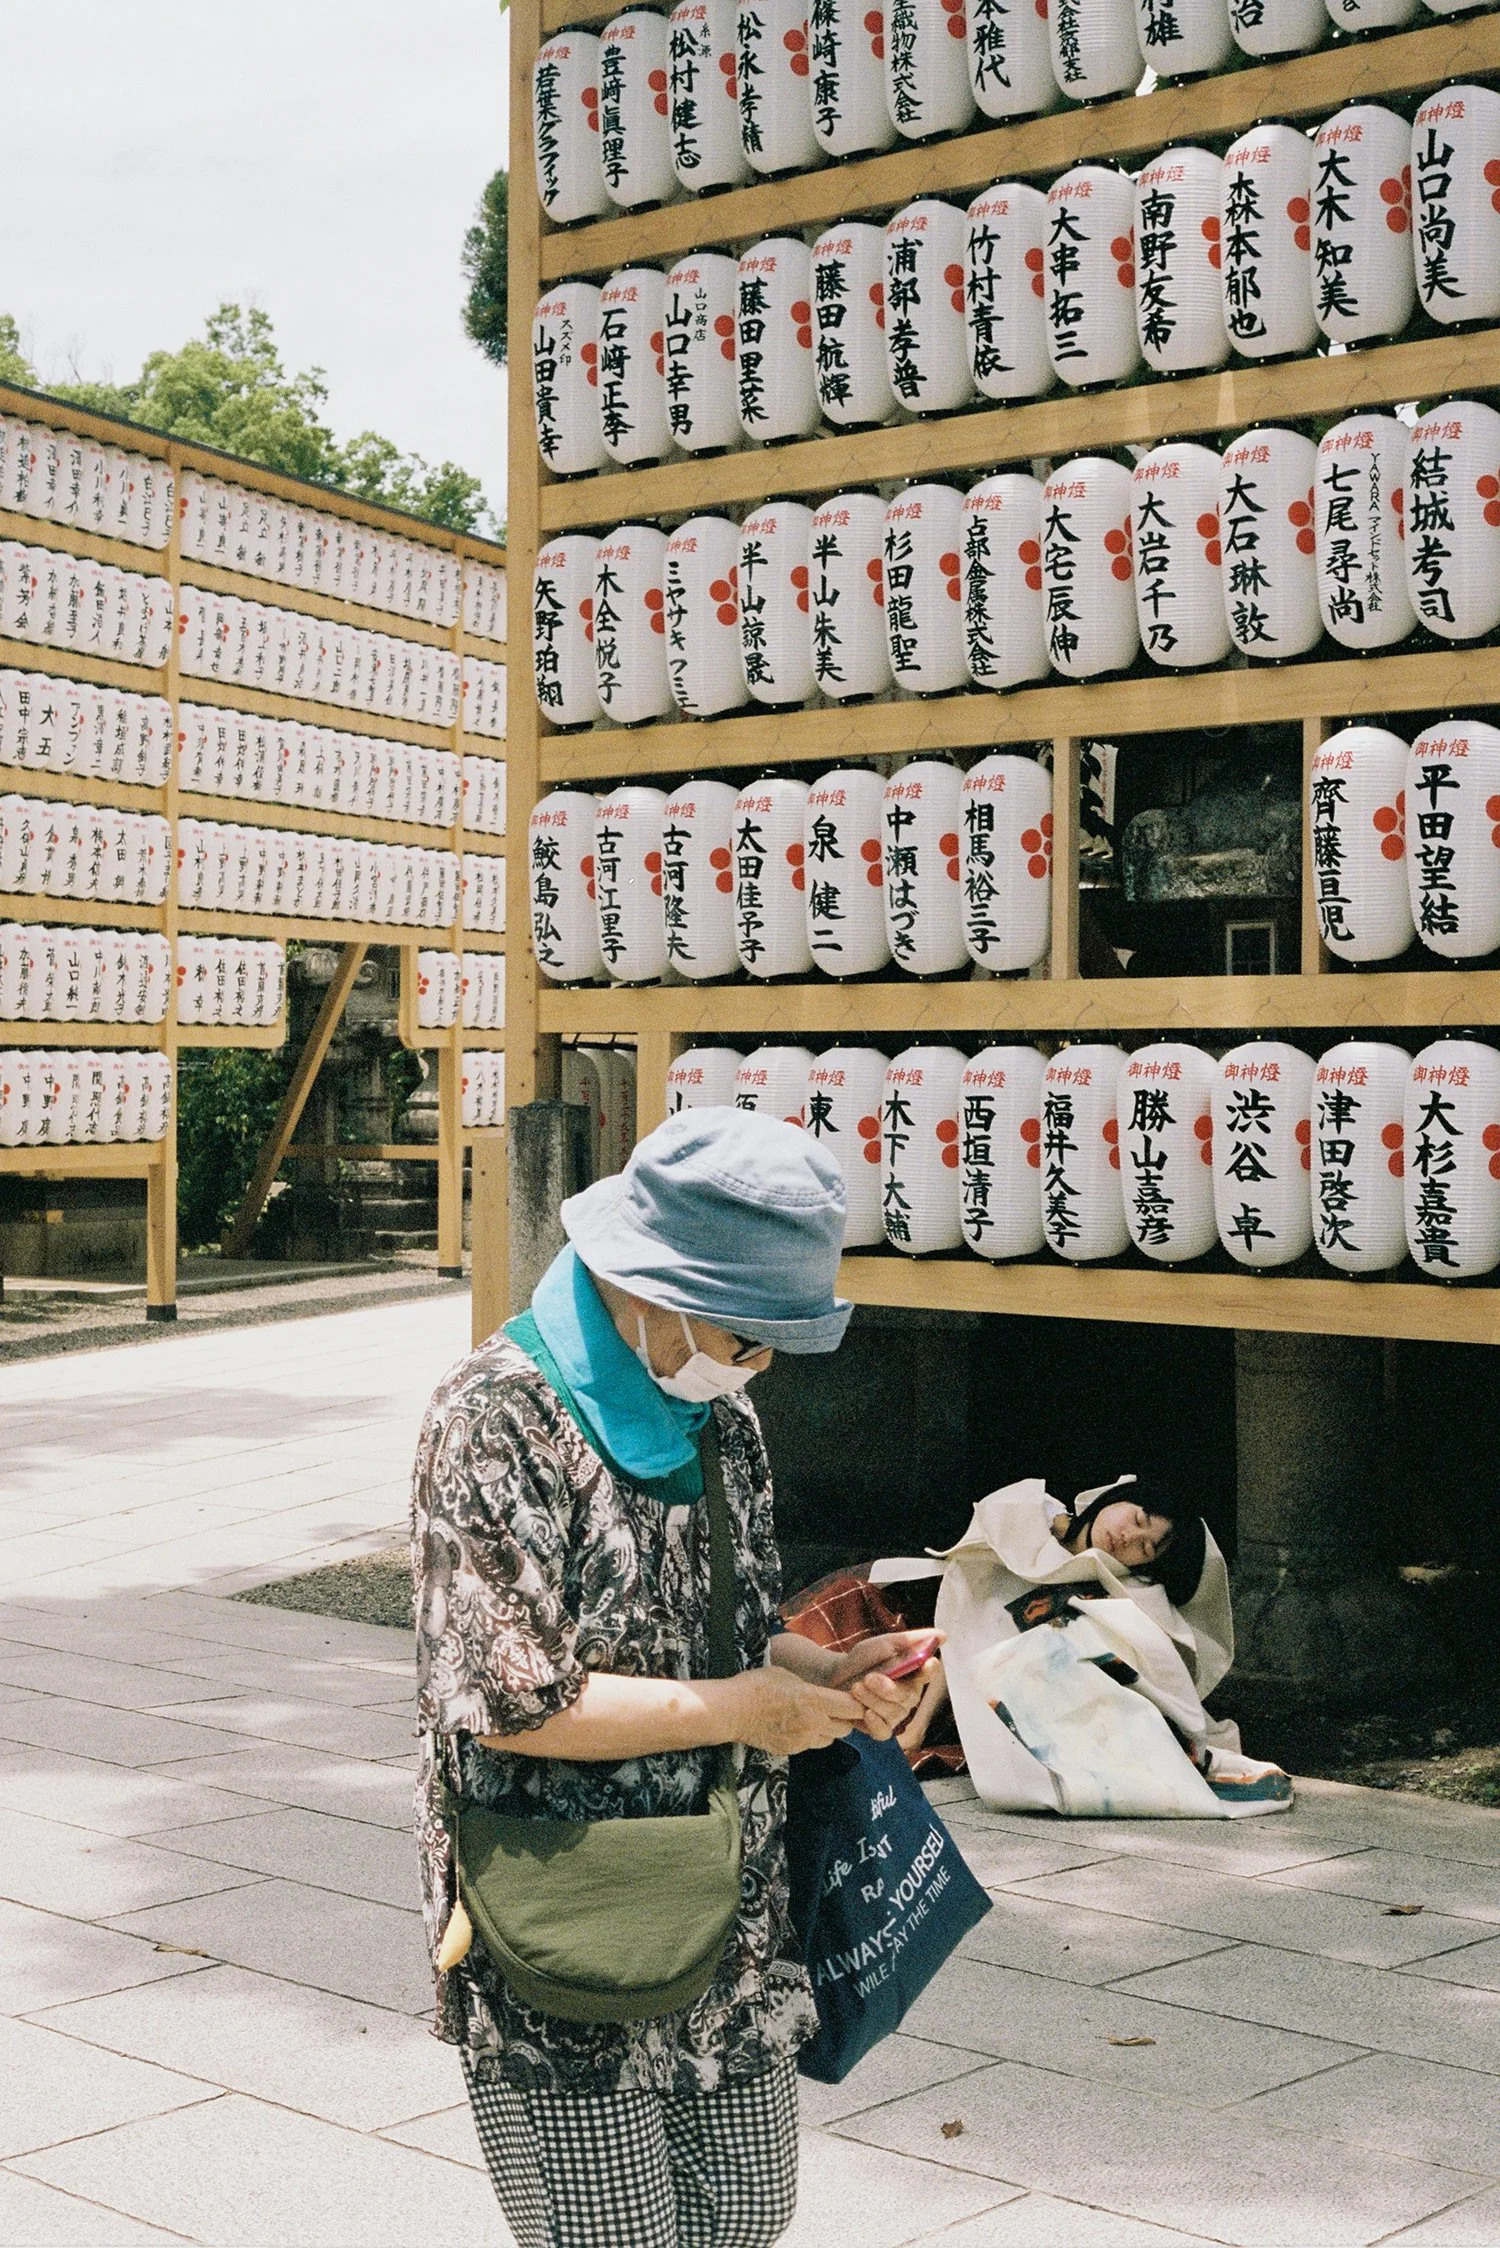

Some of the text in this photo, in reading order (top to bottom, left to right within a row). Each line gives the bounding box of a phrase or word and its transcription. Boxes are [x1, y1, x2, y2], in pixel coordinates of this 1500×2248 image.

[669, 27, 702, 171] 松村健志
[1416, 101, 1466, 126] 御神燈
[1047, 206, 1091, 362] 大串拓三
[1139, 188, 1177, 354] 南野友希
[1224, 171, 1267, 340] 森本郁也
[1315, 148, 1360, 321] 大木知美
[1416, 128, 1467, 302] 山口尚美
[534, 325, 563, 461] 山田貴幸
[665, 292, 694, 436] 山口幸男
[739, 275, 771, 424] 藤田里菜
[814, 258, 853, 408] 藤田航輝
[1322, 431, 1374, 455] 御神燈
[1370, 453, 1381, 510] YAWARA
[1411, 421, 1464, 443] 御神燈
[812, 533, 848, 682] 半山朱美
[884, 527, 921, 672] 杉田龍聖
[964, 515, 1001, 677] 占部金属株式会社
[1044, 504, 1082, 664] 大宅辰伸
[1137, 491, 1179, 653] 大岩千乃
[1223, 474, 1278, 646] 大石琳敦
[1323, 462, 1365, 625] 七尾尋尚
[1409, 446, 1456, 623] 結城考司
[595, 564, 625, 705] 木全悦子
[1415, 738, 1470, 758] 御神燈
[532, 834, 564, 968] 鮫島弘之
[596, 825, 627, 964] 古河江里子
[662, 823, 696, 960] 古河隆夫
[736, 817, 768, 965] 太田佳予子
[885, 804, 920, 961] 中瀬はづき
[964, 798, 1001, 955] 相馬裕三子
[1415, 764, 1460, 936] 平田望結
[807, 1090, 841, 1138] 東
[1127, 1061, 1183, 1080] 御神燈
[1225, 1062, 1281, 1083] 御神燈
[1317, 1066, 1369, 1086] 御神燈
[1413, 1066, 1470, 1086] 御神燈
[883, 1089, 916, 1243] 木下大輔
[962, 1095, 996, 1243] 西垣清子
[1043, 1091, 1082, 1248] 福井久美子
[1127, 1089, 1177, 1246] 勝山嘉彦
[1317, 1089, 1362, 1251] 津田啓次
[1412, 1090, 1464, 1268] 大杉嘉貴
[906, 1898, 930, 1930] THE
[925, 1865, 951, 1903] TIME
